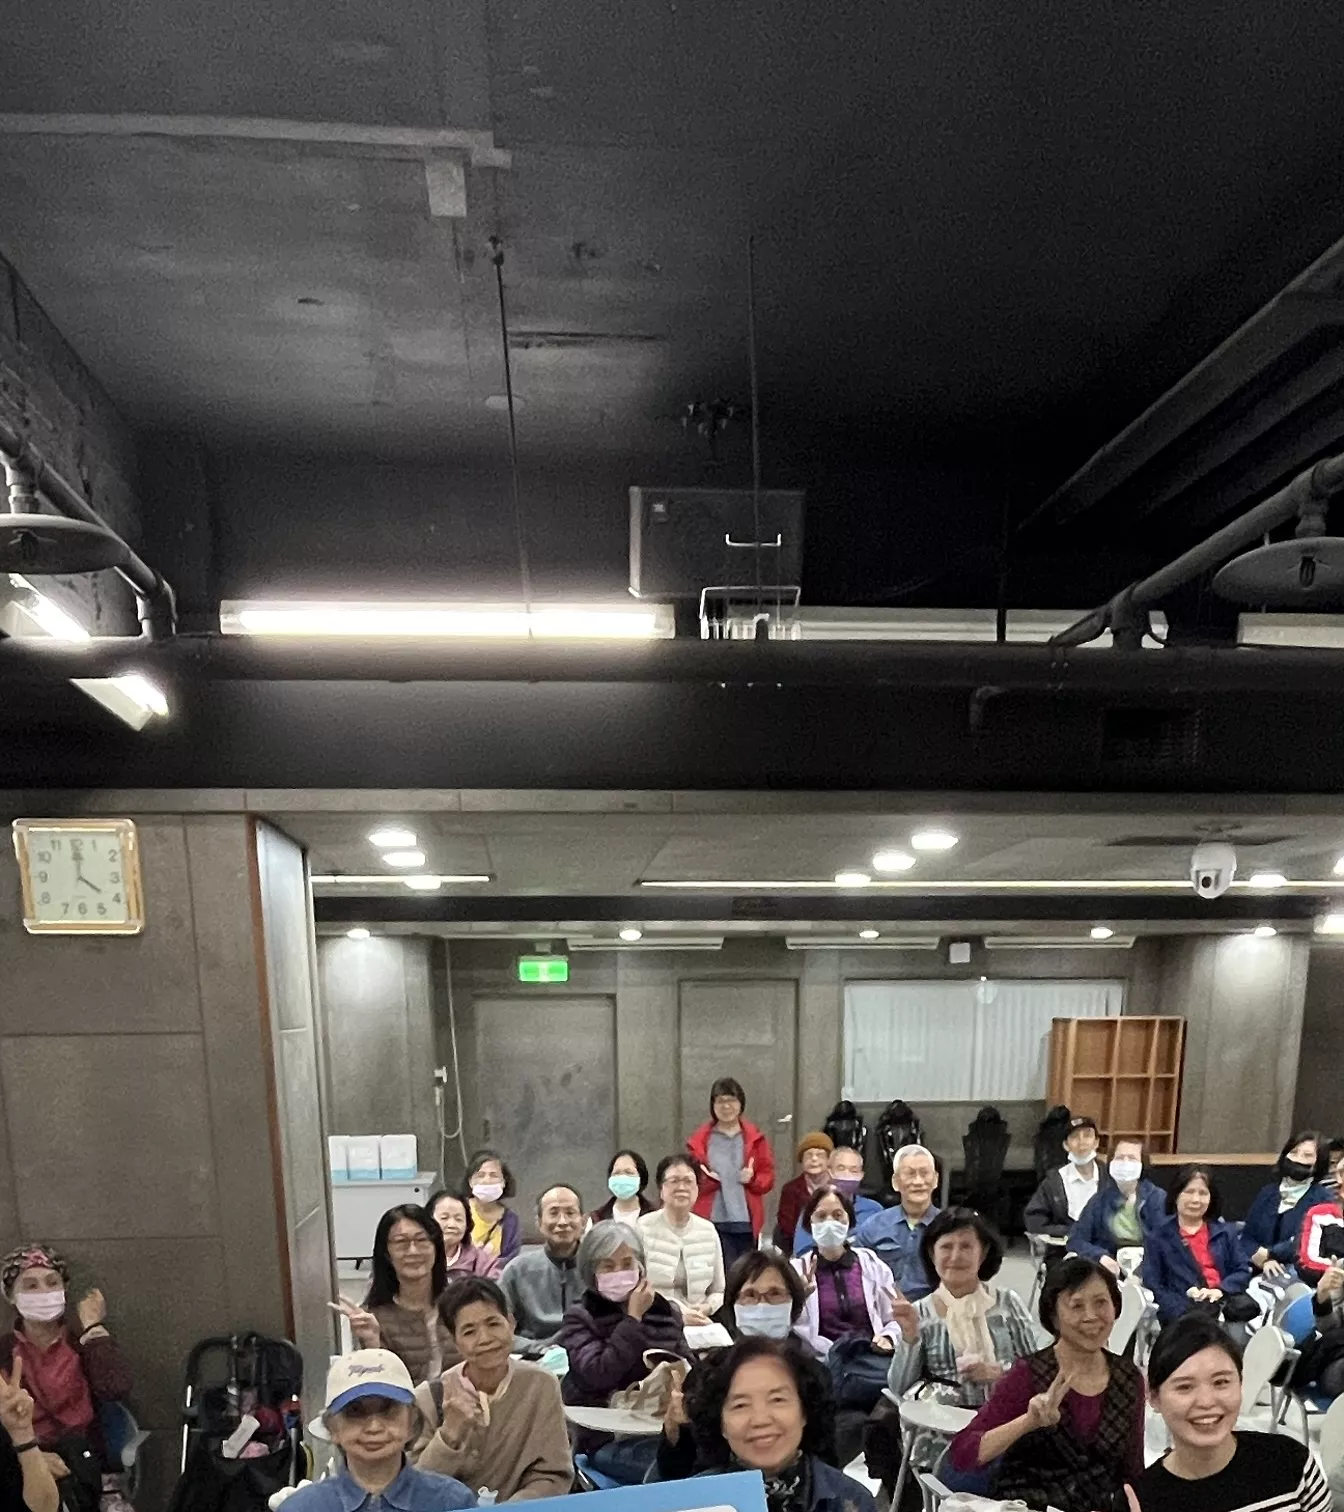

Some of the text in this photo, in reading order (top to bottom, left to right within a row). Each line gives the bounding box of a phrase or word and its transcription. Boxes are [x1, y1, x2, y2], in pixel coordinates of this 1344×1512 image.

[108, 848, 118, 862] 2
[37, 871, 48, 883] 9
[109, 871, 120, 884] 3
[111, 892, 121, 903] 4
[60, 902, 69, 914] 7
[78, 902, 88, 915] 6
[96, 902, 107, 915] 5
